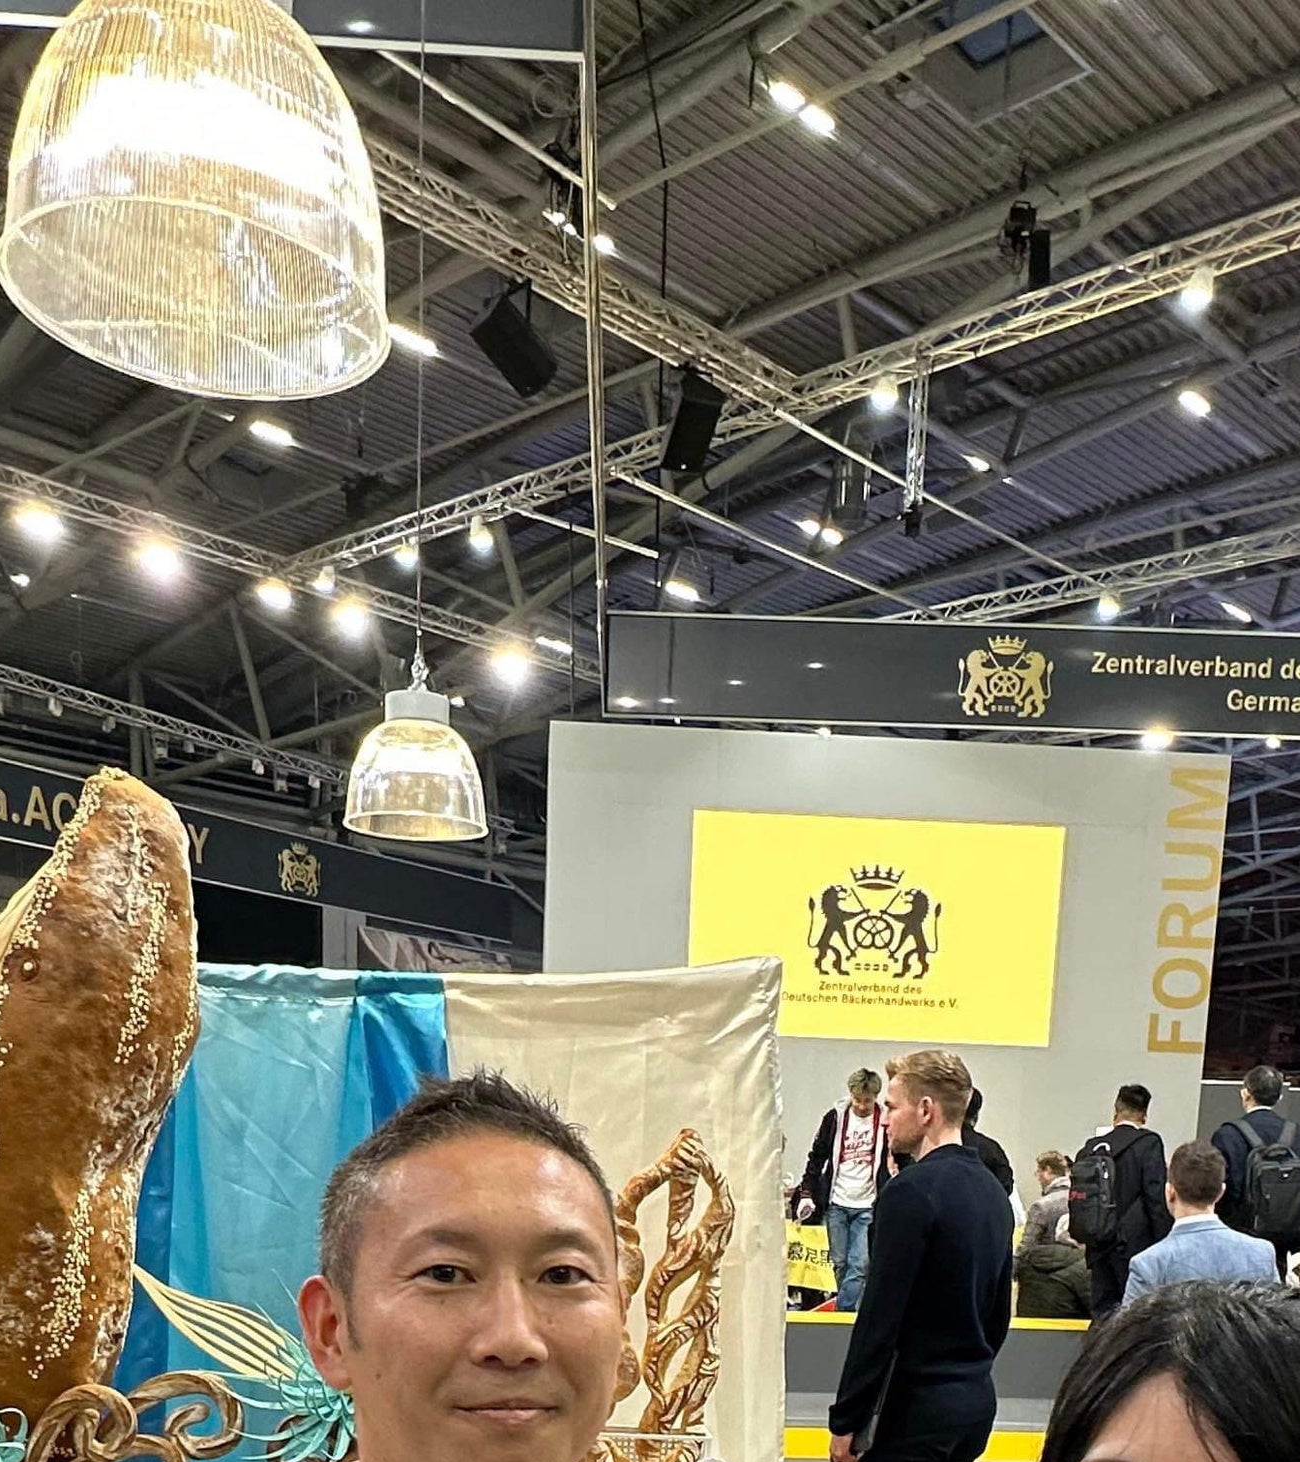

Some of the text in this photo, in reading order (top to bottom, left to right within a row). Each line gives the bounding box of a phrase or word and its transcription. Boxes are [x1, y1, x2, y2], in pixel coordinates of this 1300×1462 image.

[1091, 651, 1272, 681] Zentralverband
[1147, 767, 1231, 1055] FORUM
[818, 980, 922, 995] Zentralverband des
[841, 993, 936, 1008] Bäckerhandwerks
